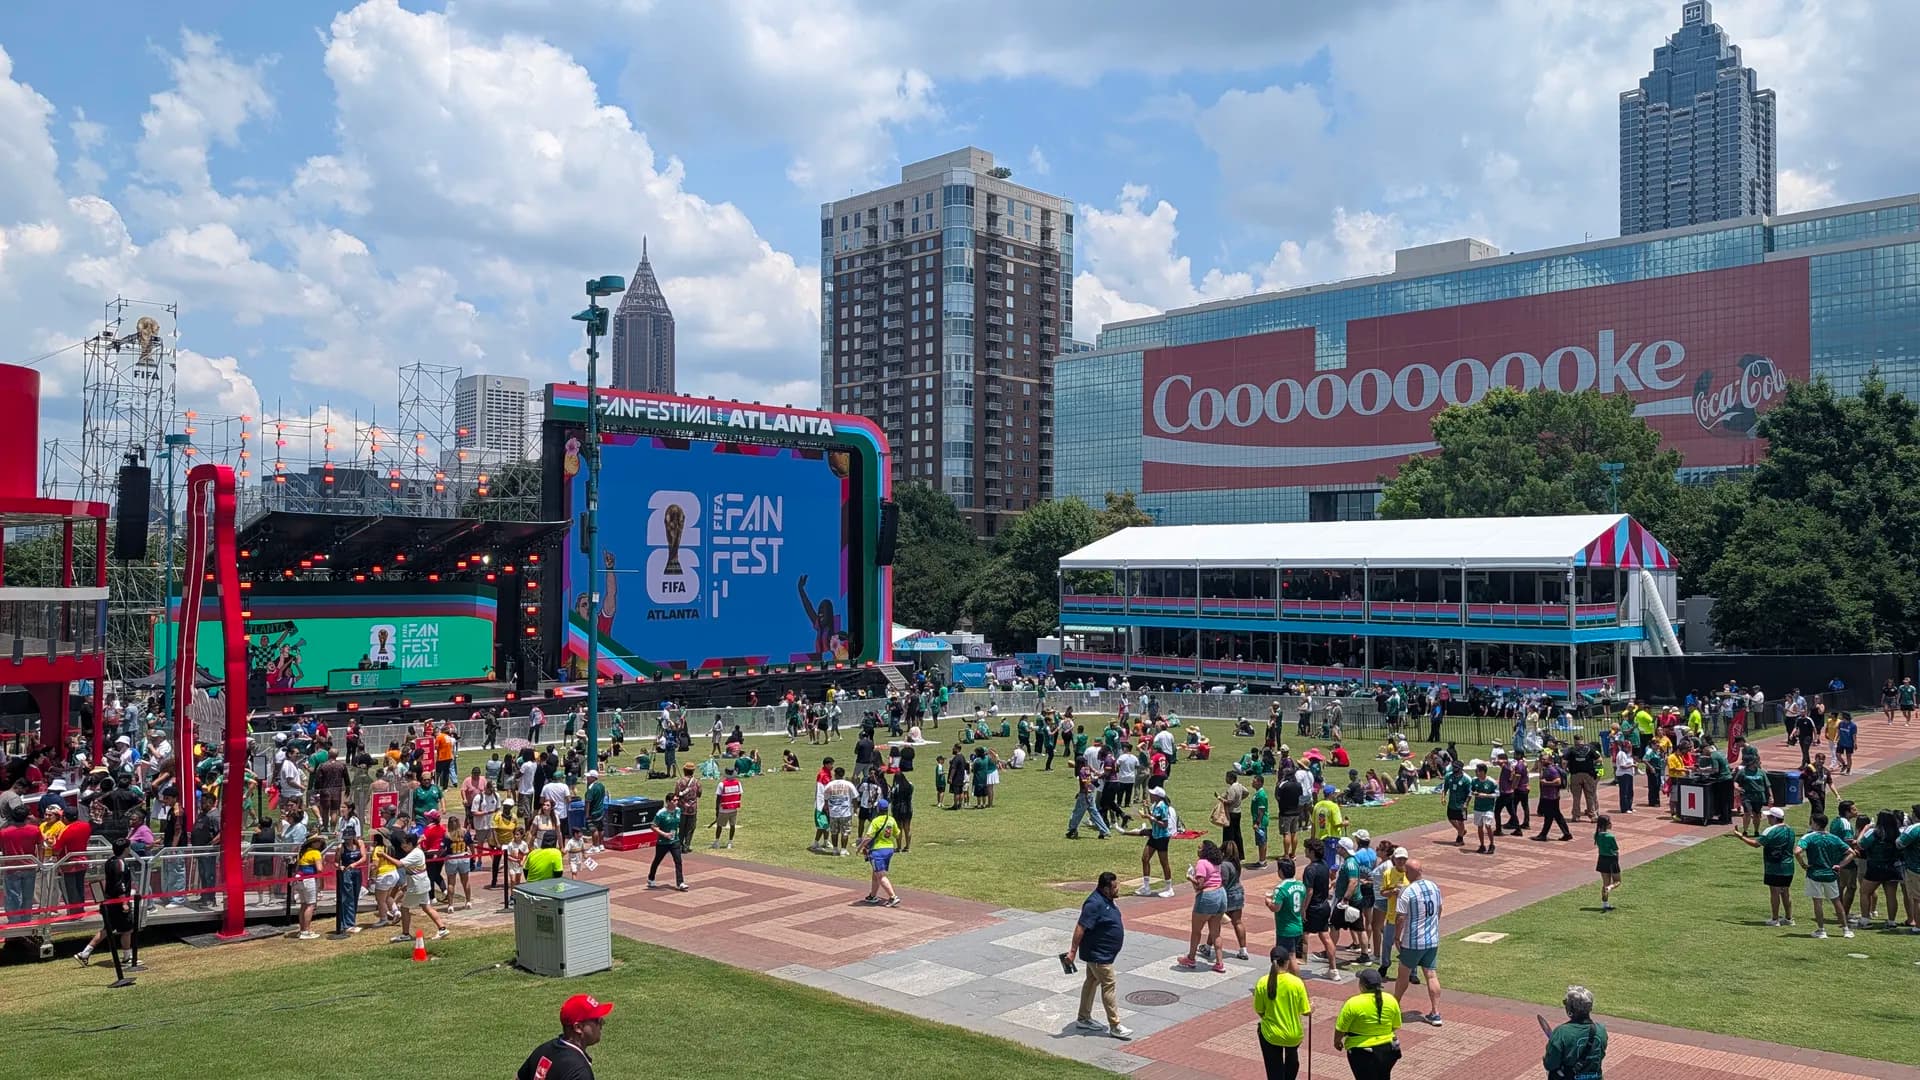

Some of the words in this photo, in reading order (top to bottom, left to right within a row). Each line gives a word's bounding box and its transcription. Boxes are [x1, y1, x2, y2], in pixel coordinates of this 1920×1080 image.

[134, 371, 160, 380] FIFA
[1695, 358, 1786, 430] Coca-Cola
[728, 409, 834, 436] ATLANTA
[713, 493, 724, 531] FIFA
[726, 493, 783, 532] FAN
[712, 536, 784, 574] FEST
[662, 581, 686, 594] FIFA
[647, 608, 700, 621] ATLANTA
[409, 623, 439, 637] FAN
[402, 638, 440, 653] FEST
[1293, 891, 1301, 913] 9
[1423, 900, 1435, 918] 10
